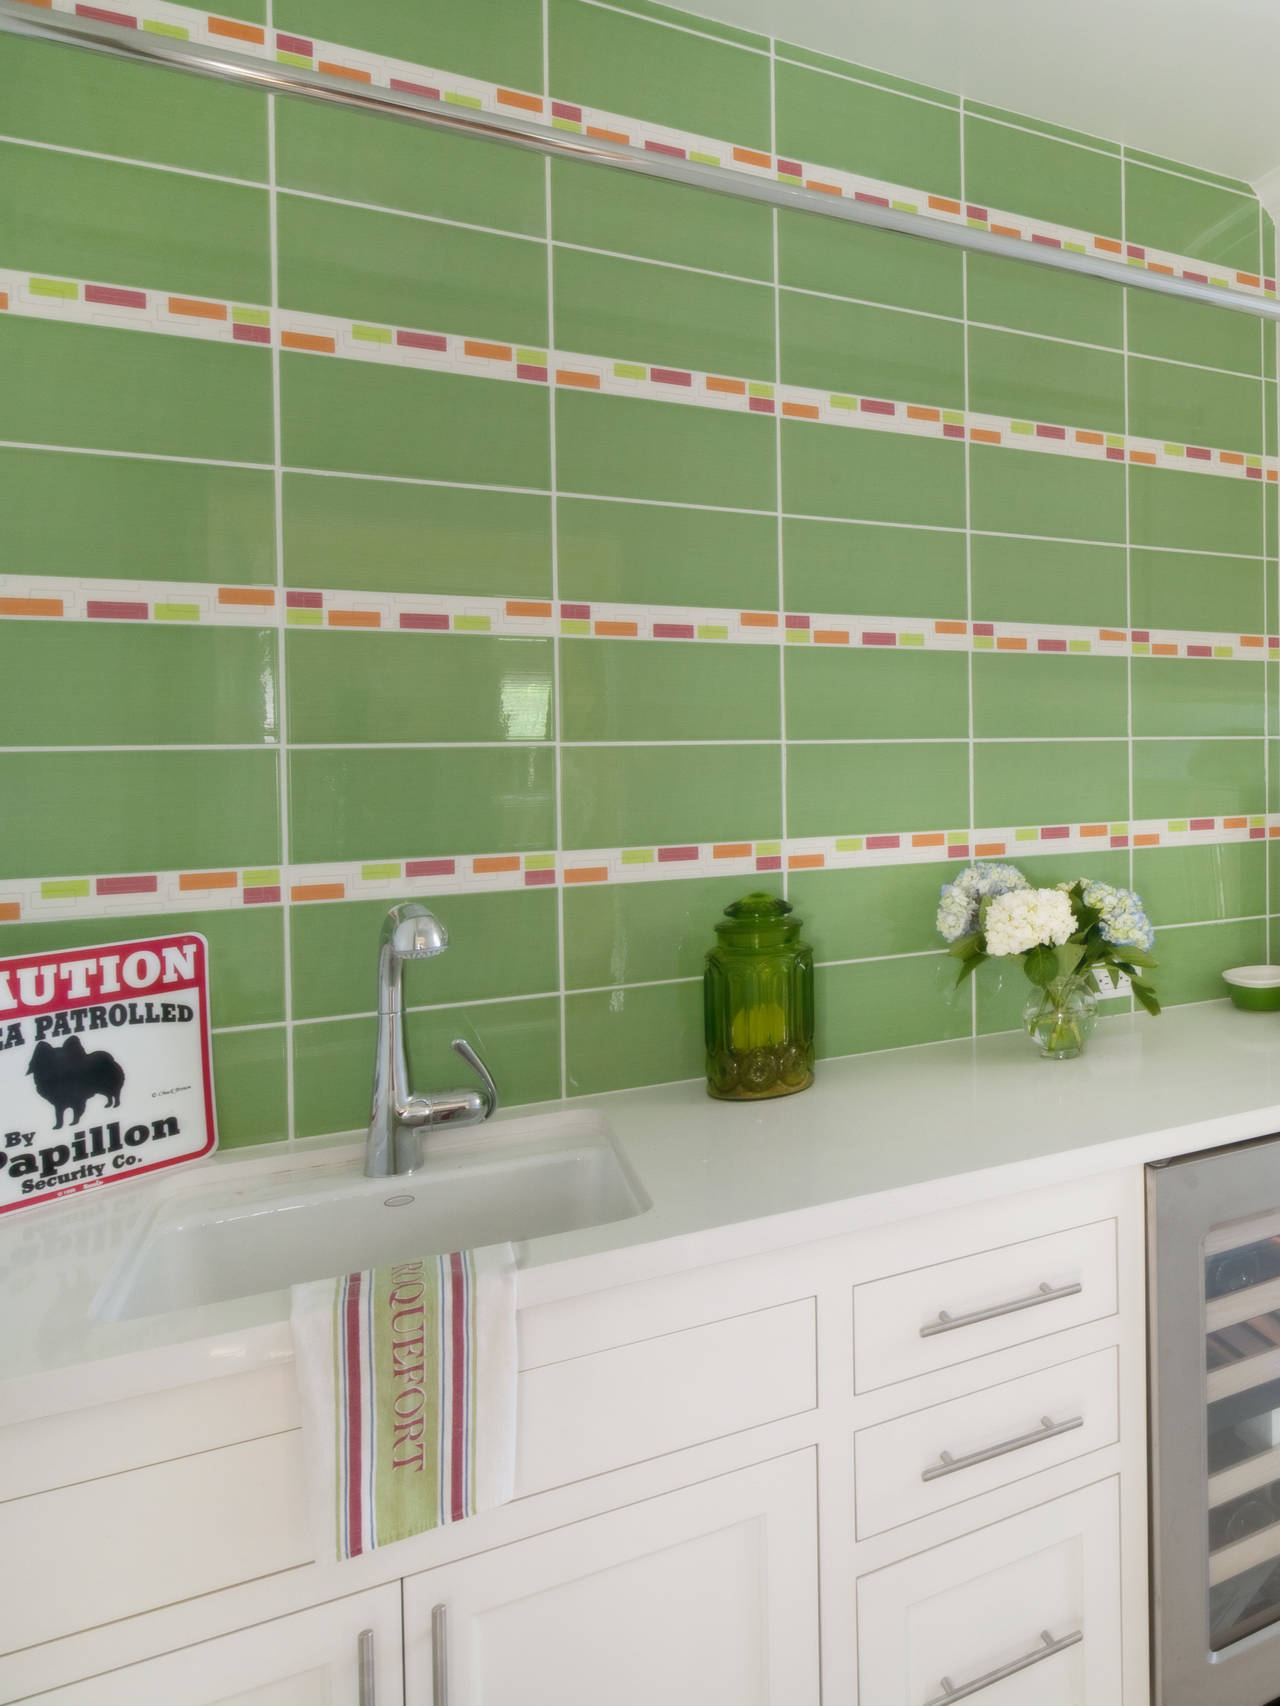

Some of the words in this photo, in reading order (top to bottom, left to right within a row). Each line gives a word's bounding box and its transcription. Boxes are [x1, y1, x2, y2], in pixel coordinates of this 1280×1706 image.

[0, 1022, 25, 1051] A
[34, 1003, 194, 1042] PATROLLED
[4, 1131, 36, 1149] By
[21, 1163, 106, 1195] Security
[112, 1153, 143, 1170] Co.
[389, 1261, 425, 1474] ROQUEFORT
